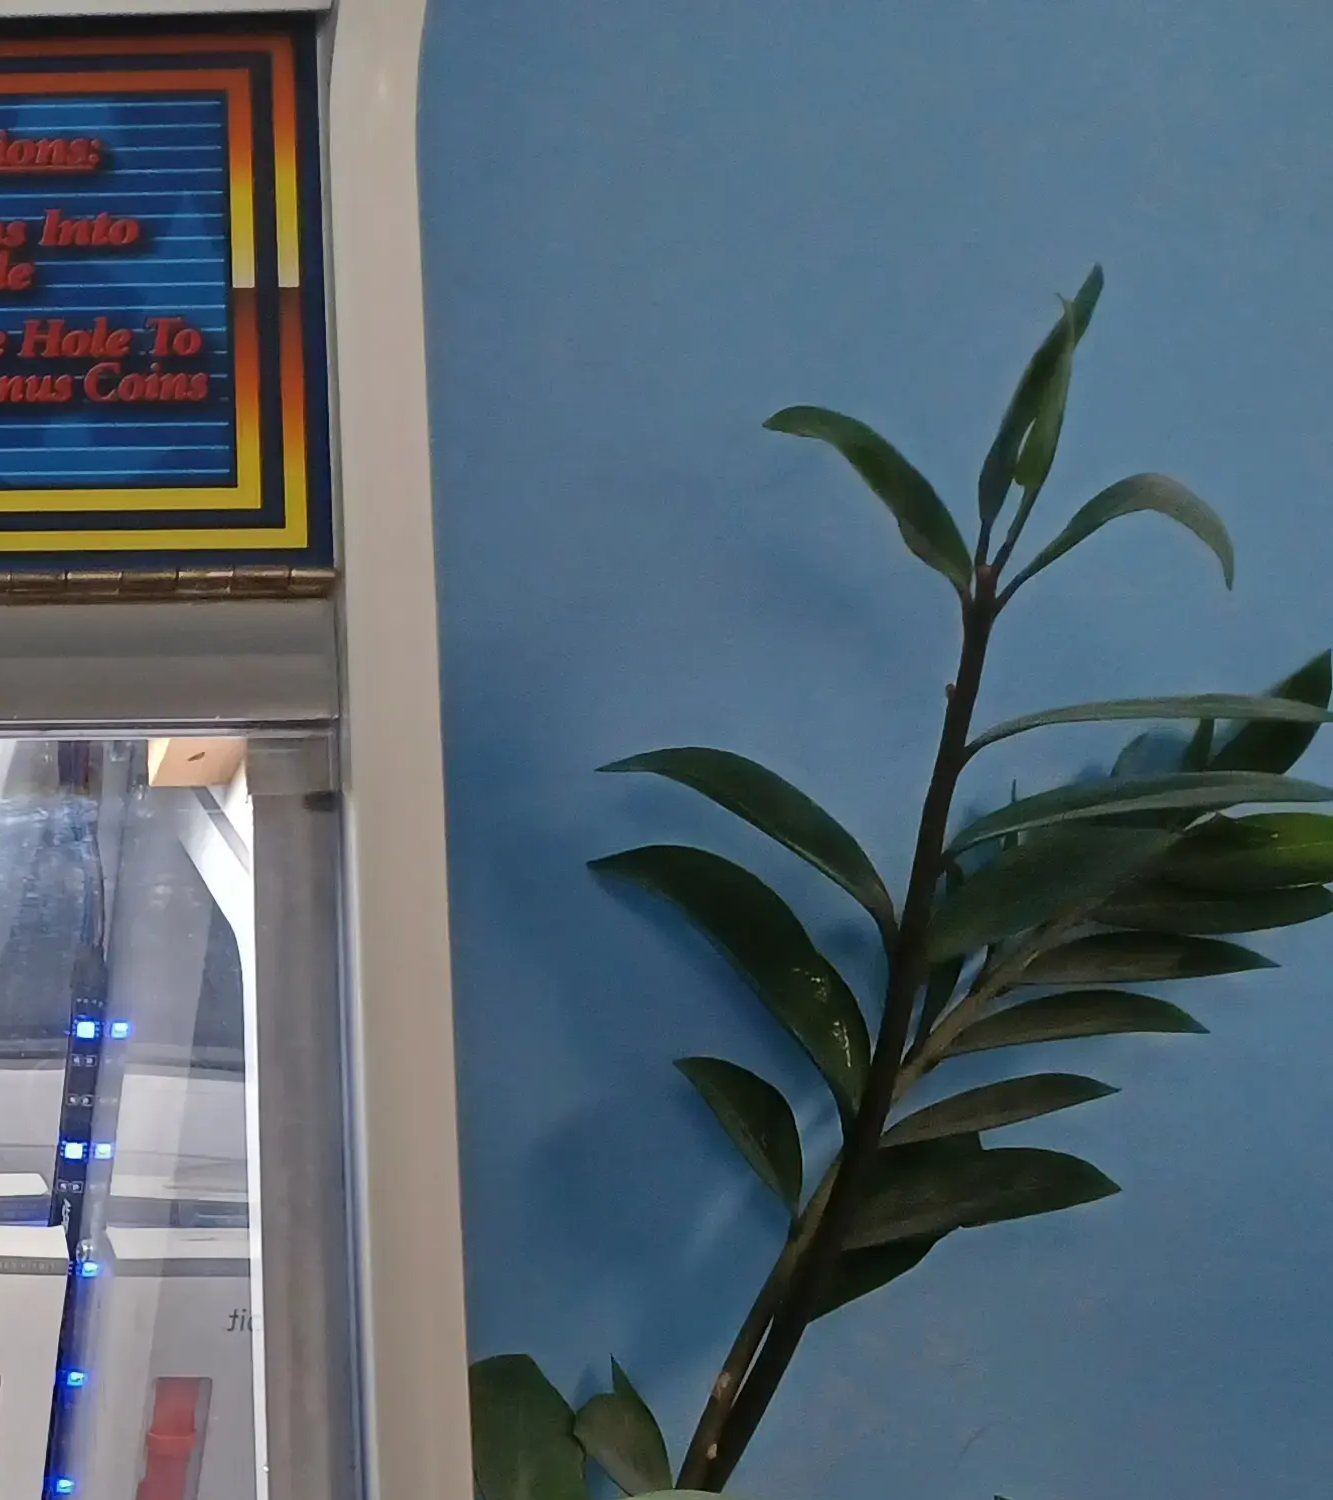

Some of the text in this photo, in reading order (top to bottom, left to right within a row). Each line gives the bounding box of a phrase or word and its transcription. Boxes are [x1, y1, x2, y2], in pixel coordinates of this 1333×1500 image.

[37, 208, 141, 248] Into
[16, 317, 132, 358] Hole
[144, 316, 203, 357] To
[83, 361, 209, 401] Coins
